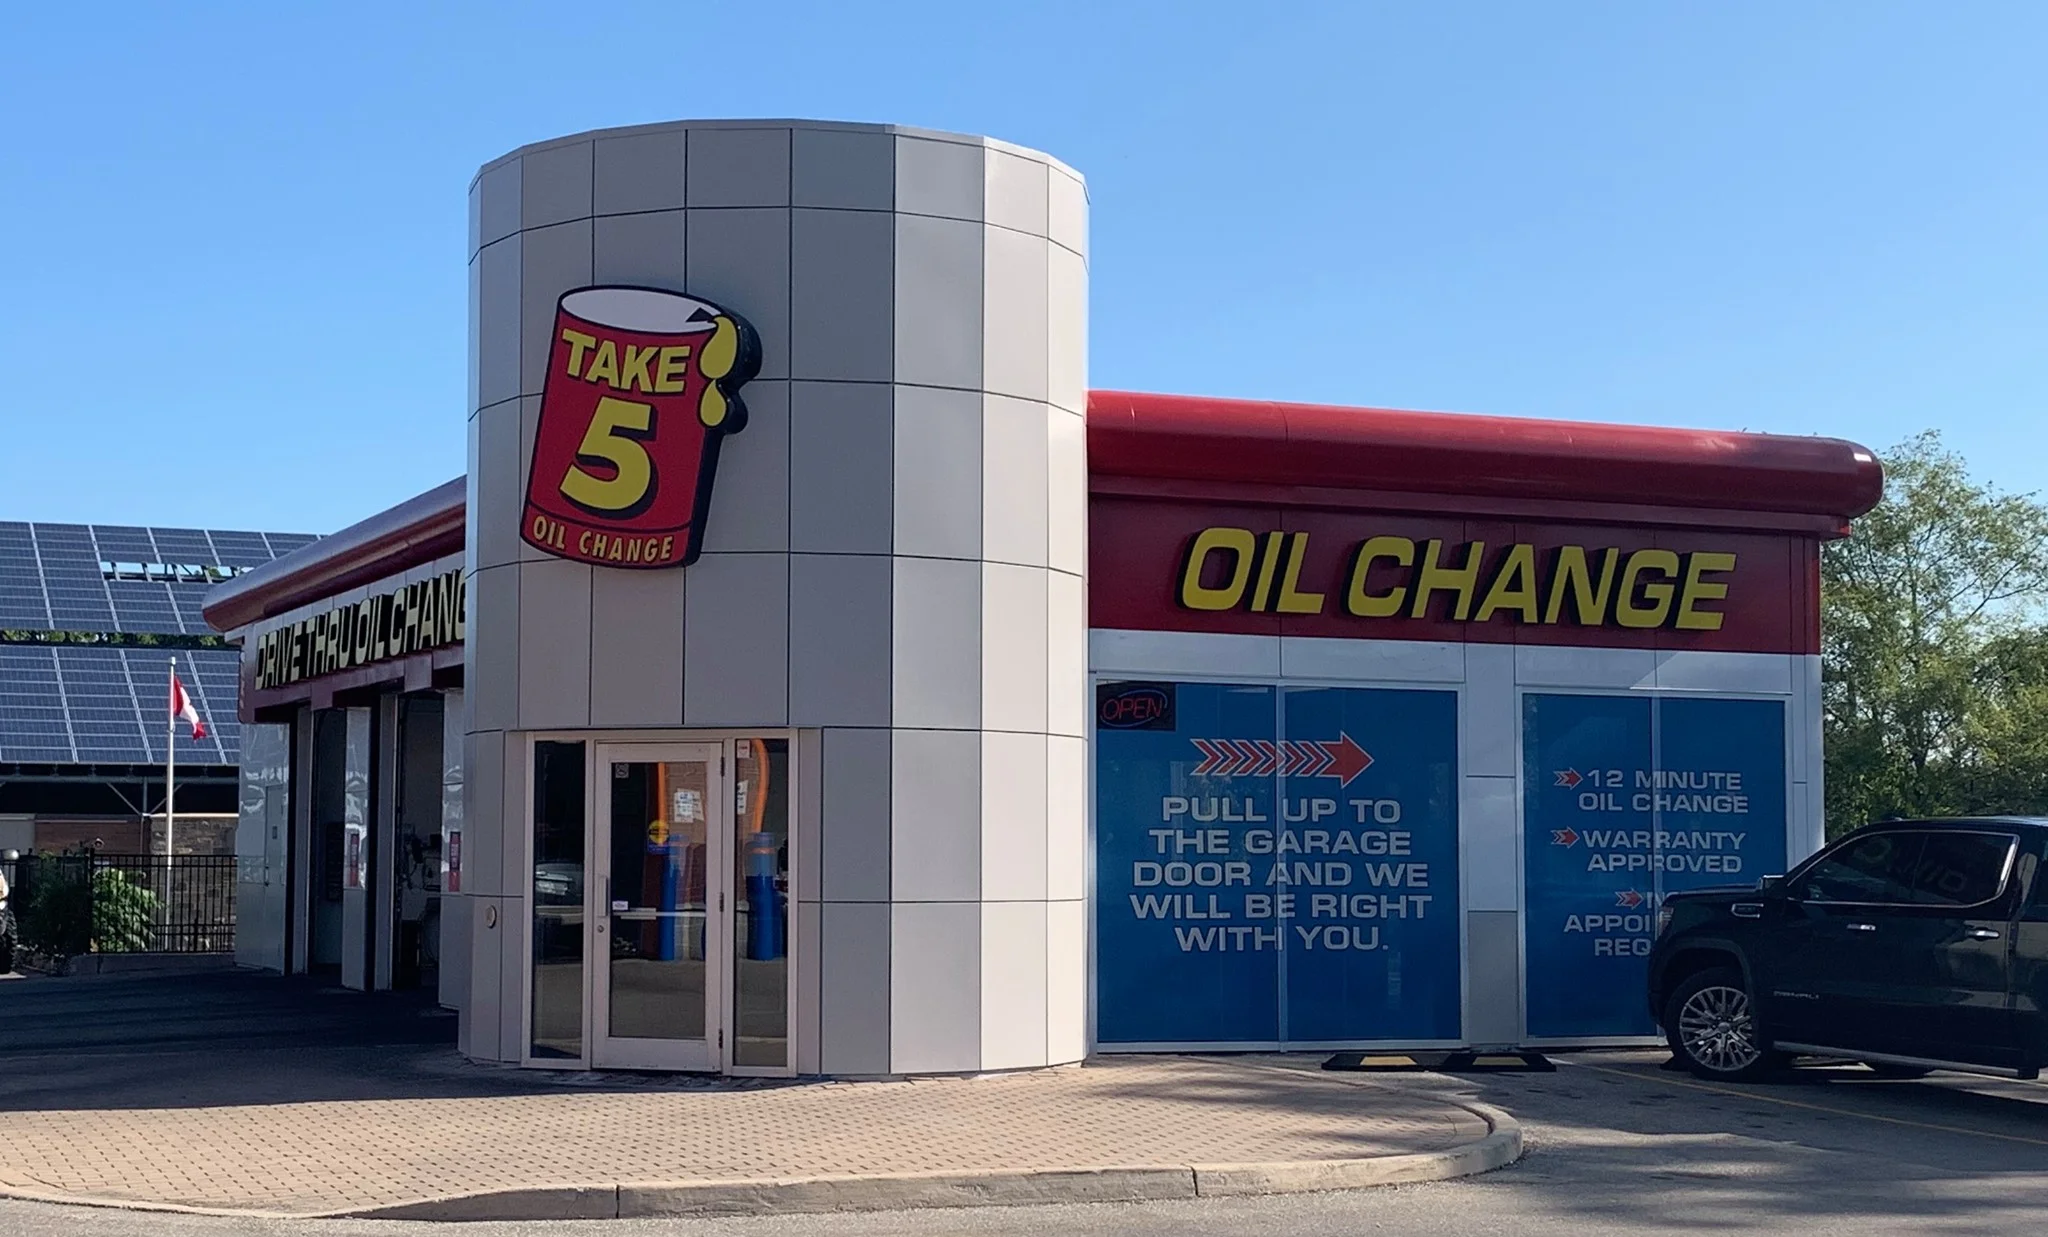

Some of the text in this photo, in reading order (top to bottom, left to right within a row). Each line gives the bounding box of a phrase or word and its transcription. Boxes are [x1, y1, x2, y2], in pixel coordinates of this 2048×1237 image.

[561, 328, 691, 393] TAKE
[559, 396, 652, 512] 5
[532, 516, 674, 563] OIL CHANGE
[1181, 527, 1737, 630] OIL CHANGE
[254, 567, 466, 690] DRIVE THRU OIL CHANG
[1102, 697, 1163, 720] OPEN
[1587, 769, 1742, 791] 12 MINUTE
[1162, 796, 1402, 824] PULL UP TO
[1578, 792, 1749, 814] OIL CHANGE
[1148, 829, 1412, 856] THE GARAGE
[1582, 830, 1746, 851] WARRANTY
[1133, 861, 1429, 888] DOOR AND WE
[1587, 853, 1742, 873] APPROVED
[1129, 894, 1433, 920] WILL BE RIGHT
[1563, 914, 1651, 933] APPOI
[1174, 926, 1390, 952] WITH YOU.
[1594, 937, 1652, 957] REQ
